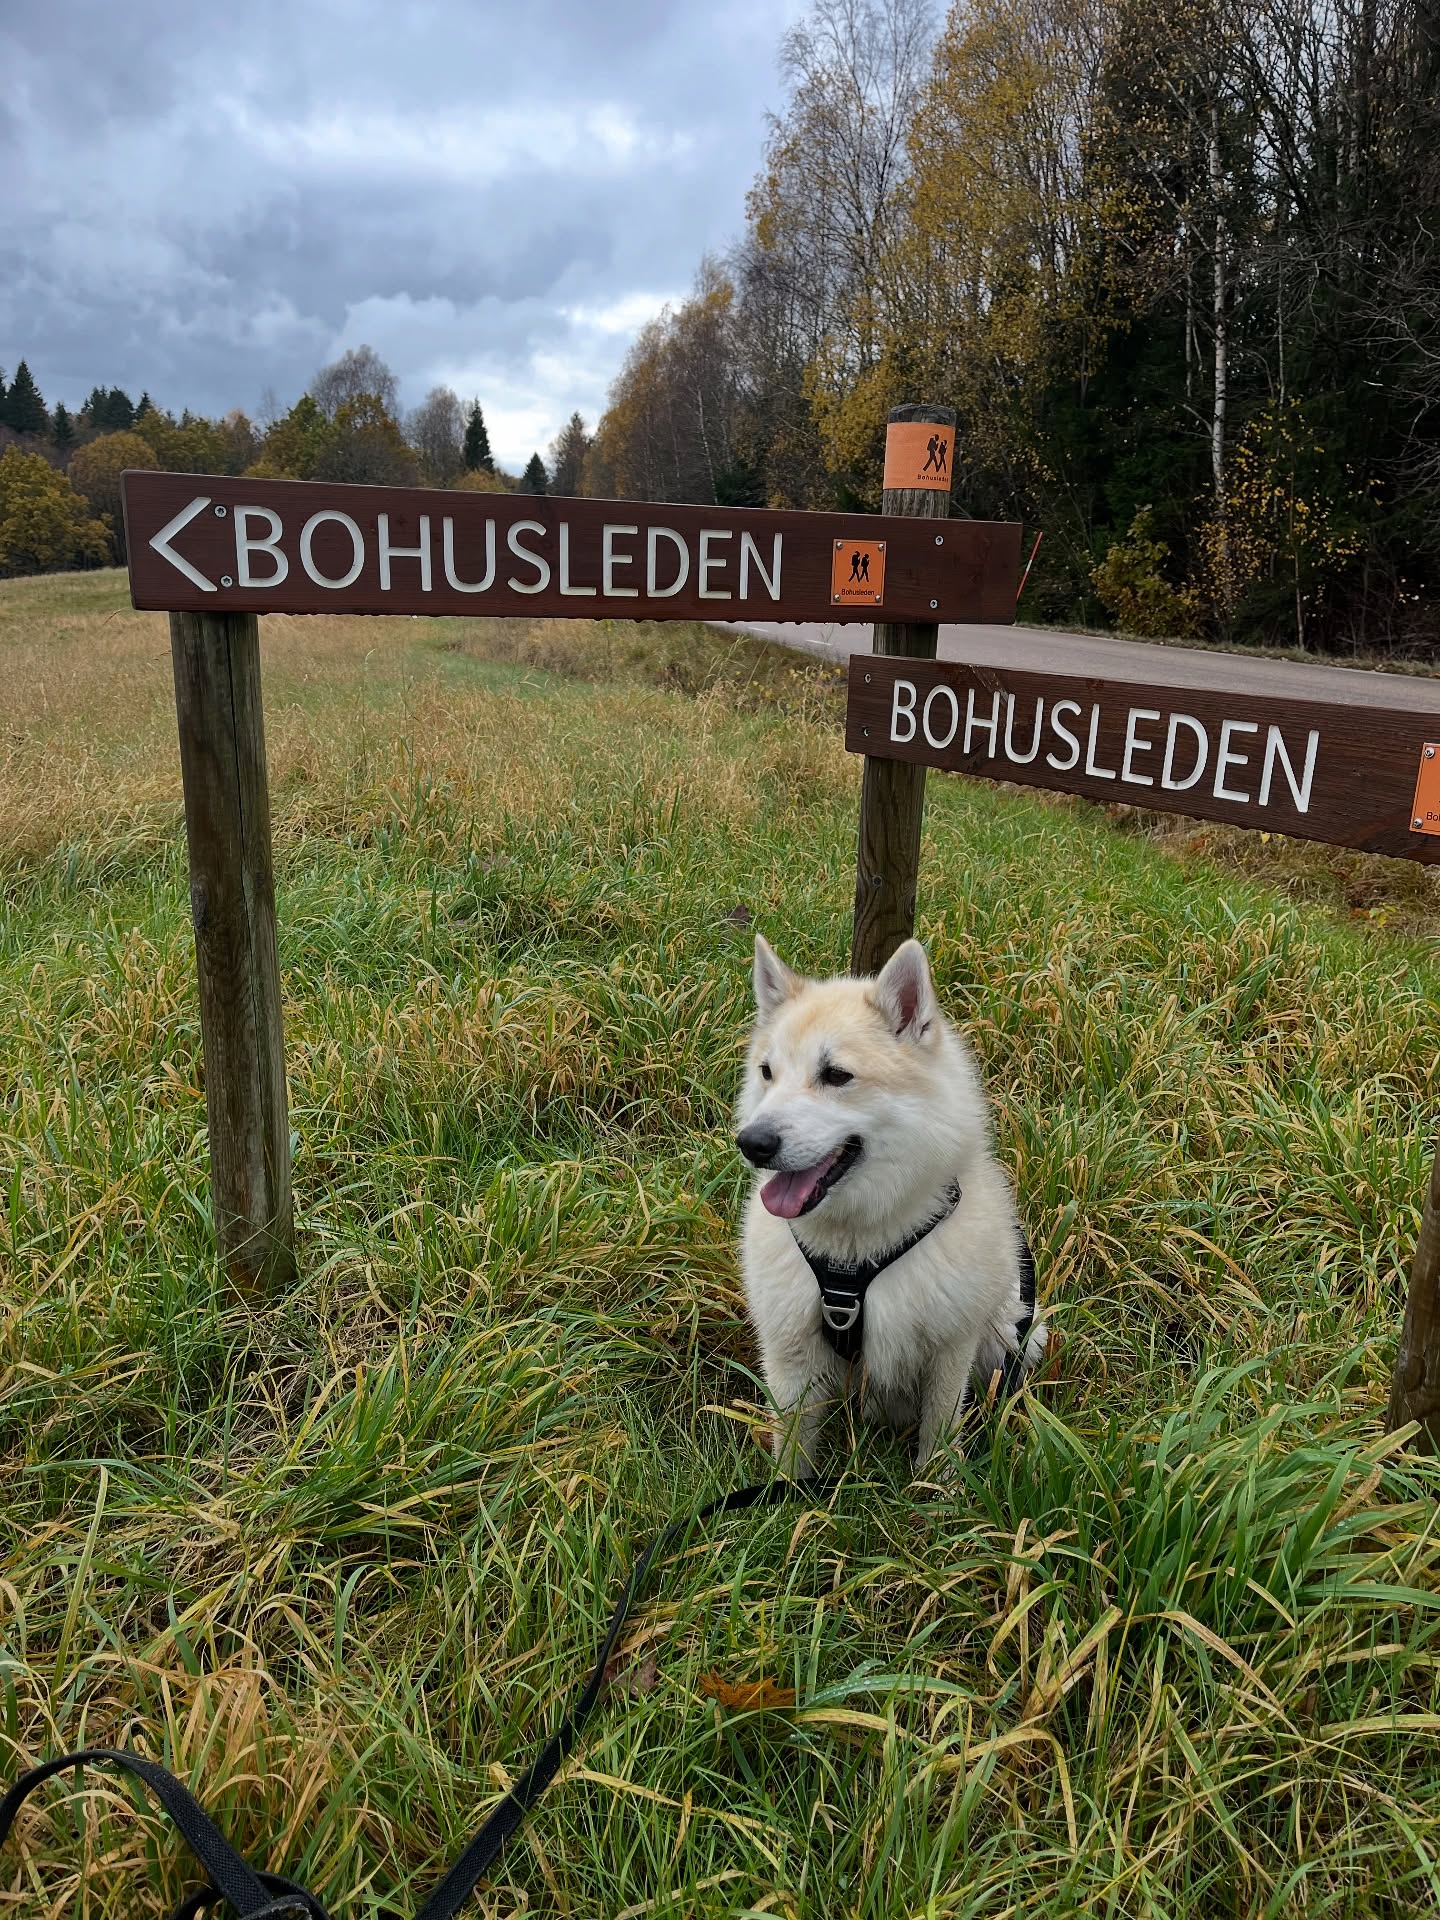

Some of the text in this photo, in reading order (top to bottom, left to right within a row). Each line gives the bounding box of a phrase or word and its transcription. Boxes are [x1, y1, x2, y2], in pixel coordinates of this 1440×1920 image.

[233, 505, 783, 601] BOHUSLEDEN
[841, 588, 875, 596] Bohusleden
[889, 679, 1320, 813] BOHUSLEDEN
[1426, 811, 1440, 822] Bo
